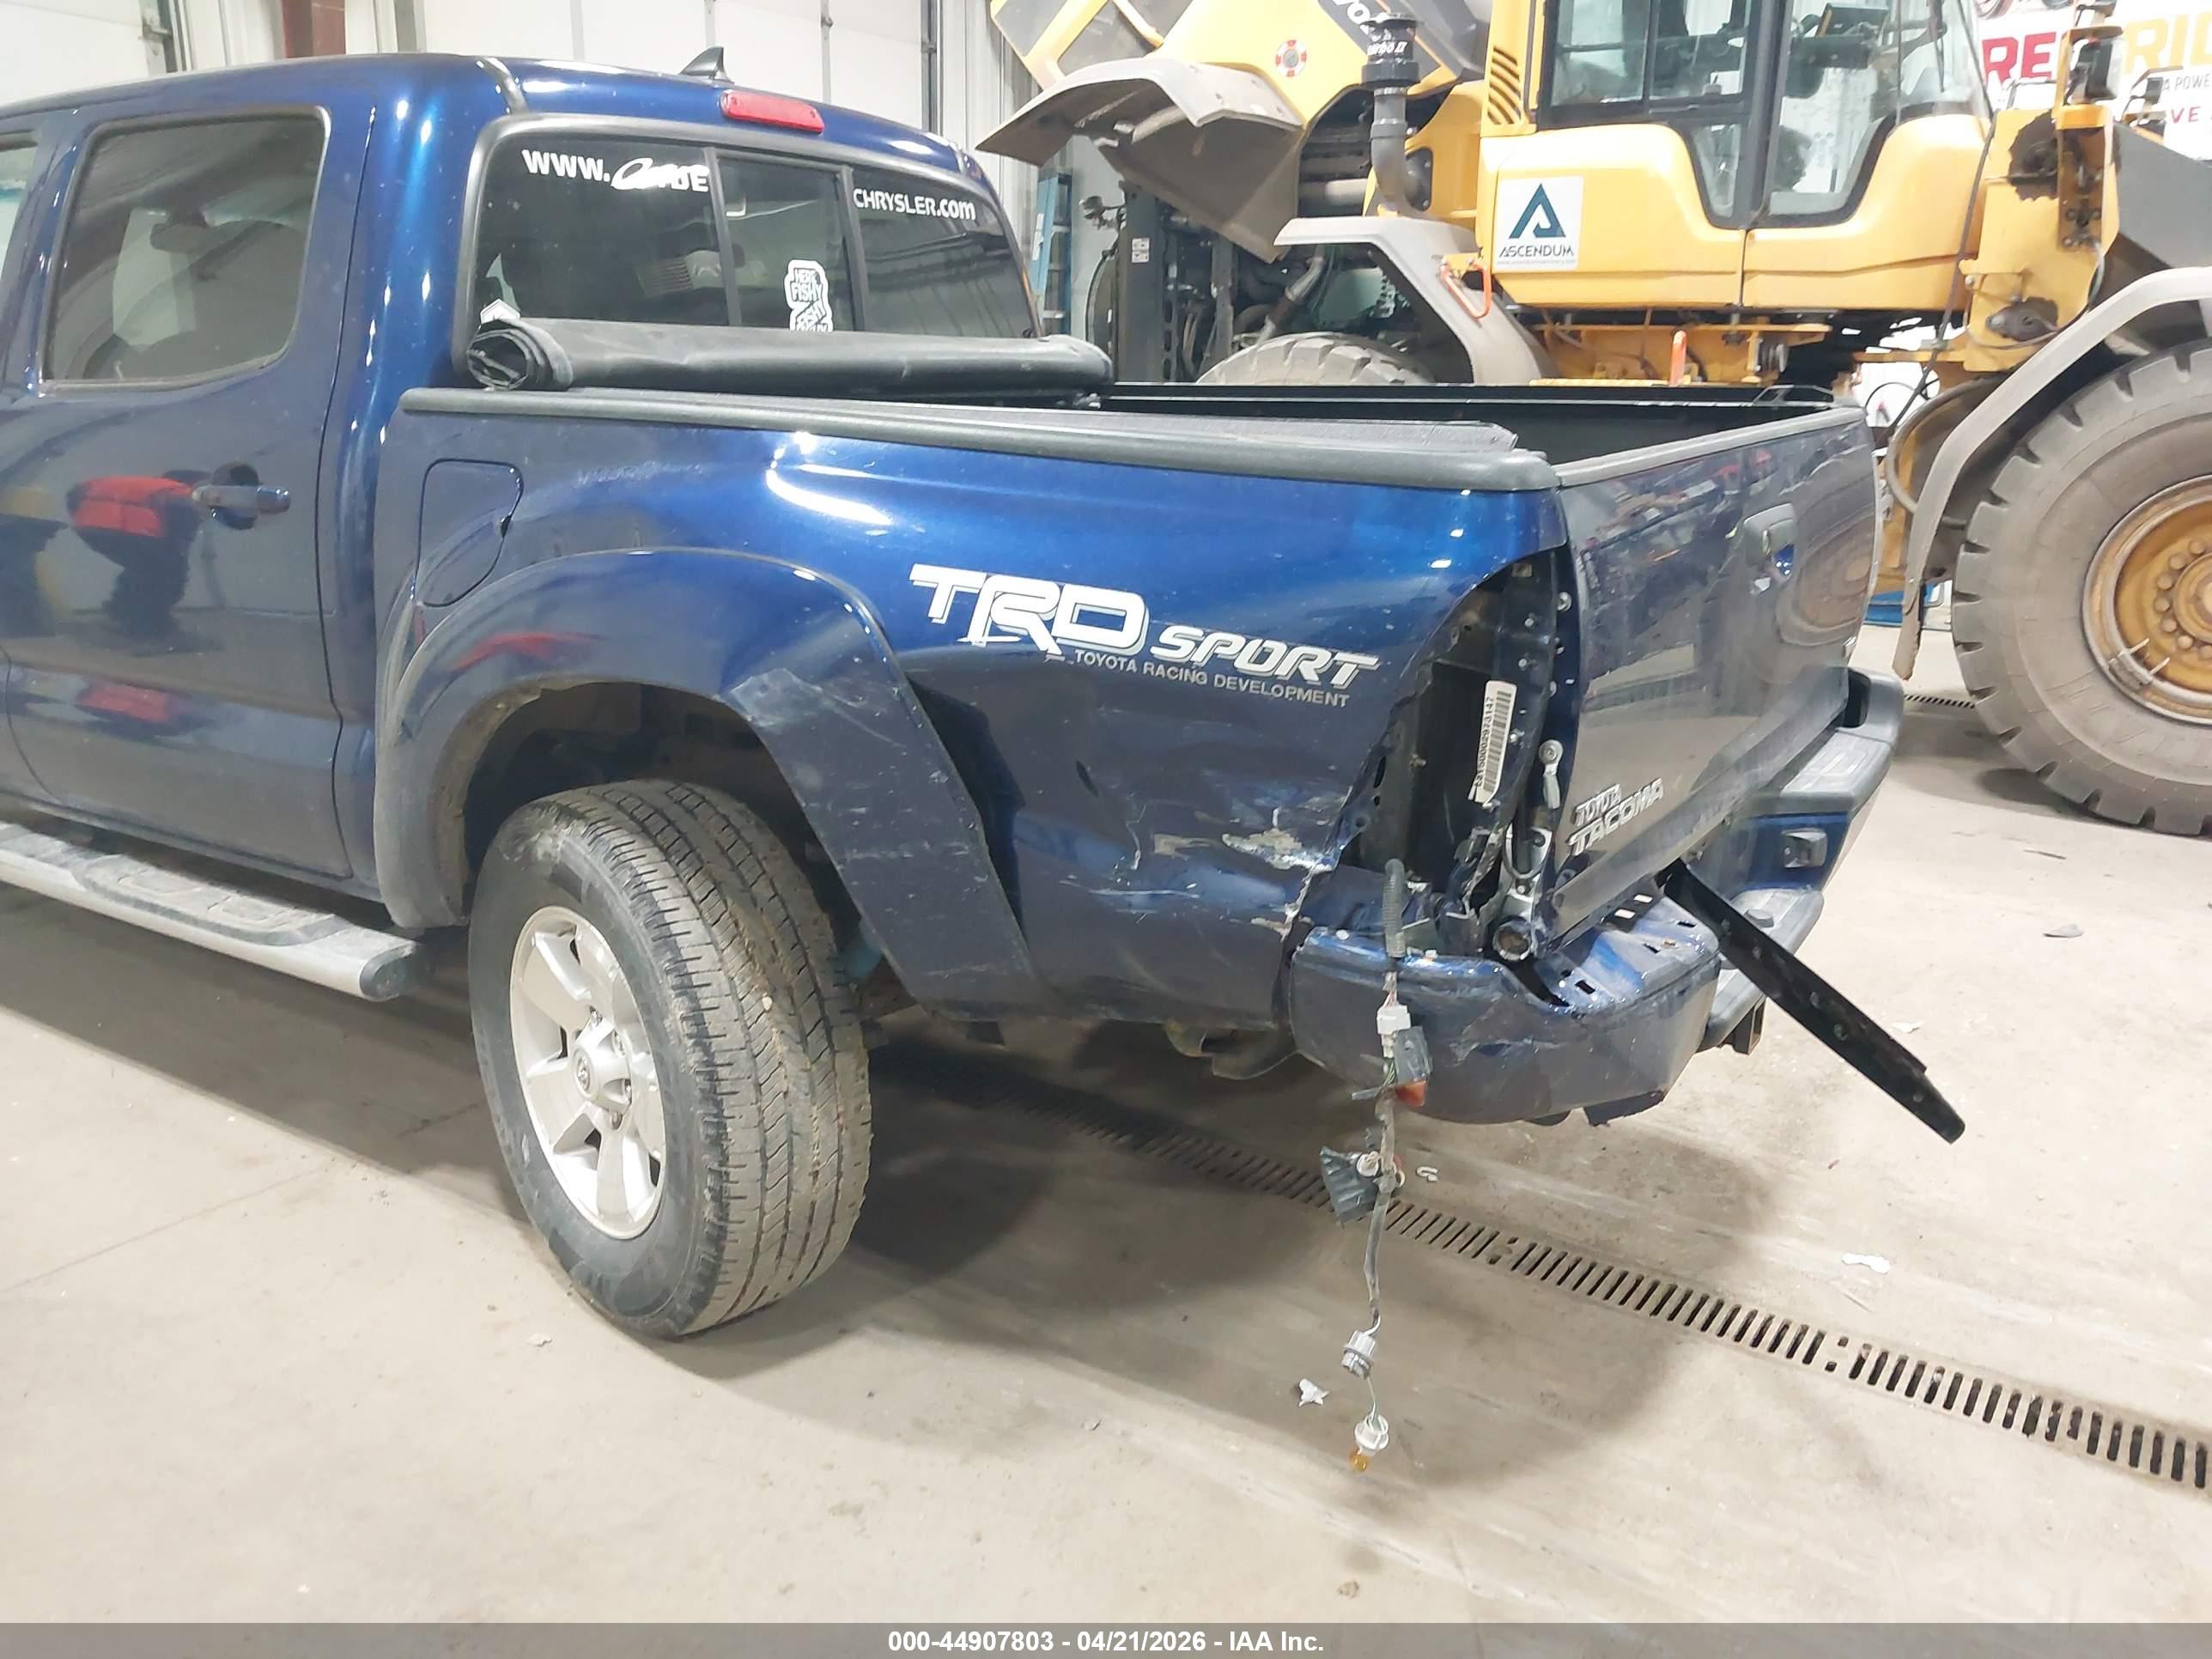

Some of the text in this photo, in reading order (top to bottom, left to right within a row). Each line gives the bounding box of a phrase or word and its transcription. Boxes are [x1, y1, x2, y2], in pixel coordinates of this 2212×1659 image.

[1498, 244, 1574, 258] ASCENDUM
[908, 563, 1151, 661] TRD
[1074, 650, 1351, 708] TOYOTA RACING DEVELOPMENT
[1150, 624, 1381, 690] SPORT
[1567, 778, 1663, 856] TACOMA
